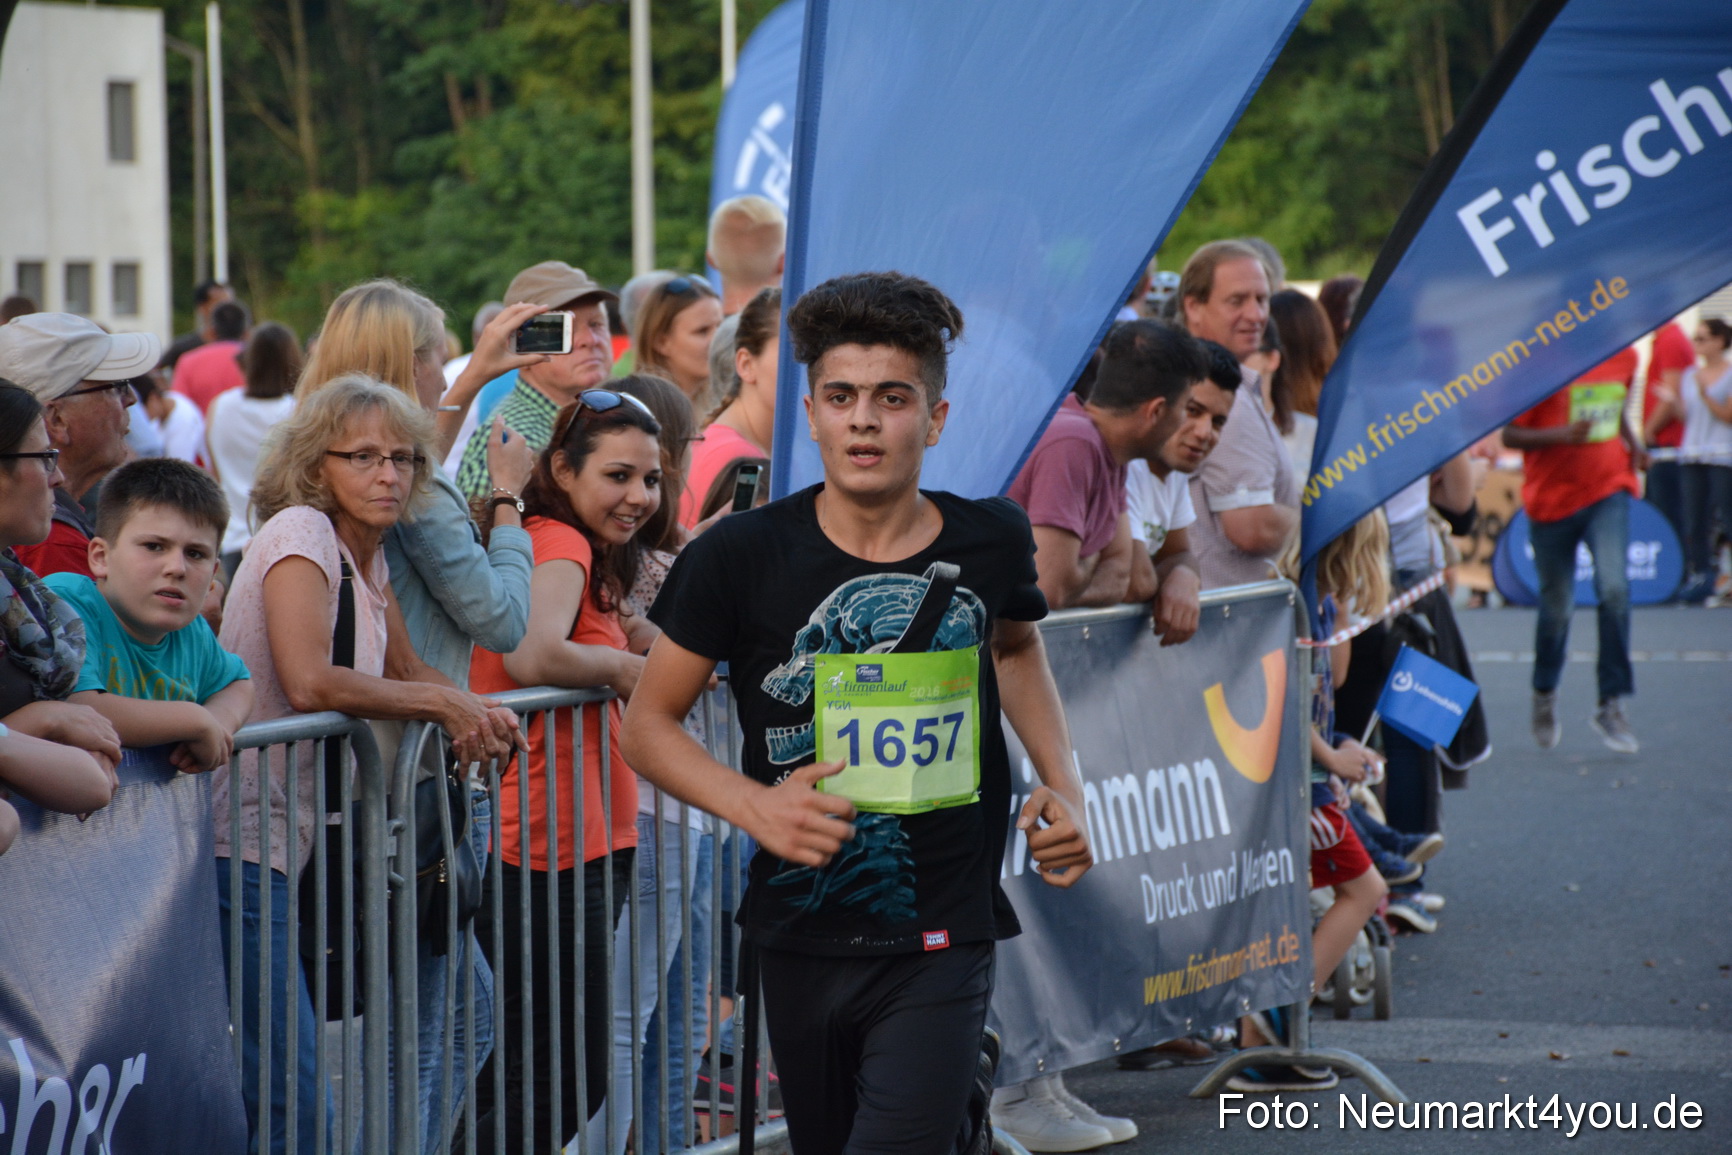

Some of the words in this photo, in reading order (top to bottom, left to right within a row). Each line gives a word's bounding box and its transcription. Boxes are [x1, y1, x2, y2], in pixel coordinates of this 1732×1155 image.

[1301, 277, 1630, 506] www.frischmann-net.de
[844, 680, 908, 692] firmenlauf
[837, 712, 965, 767] 1657
[1140, 862, 1198, 924] Druck
[1200, 851, 1236, 910] und
